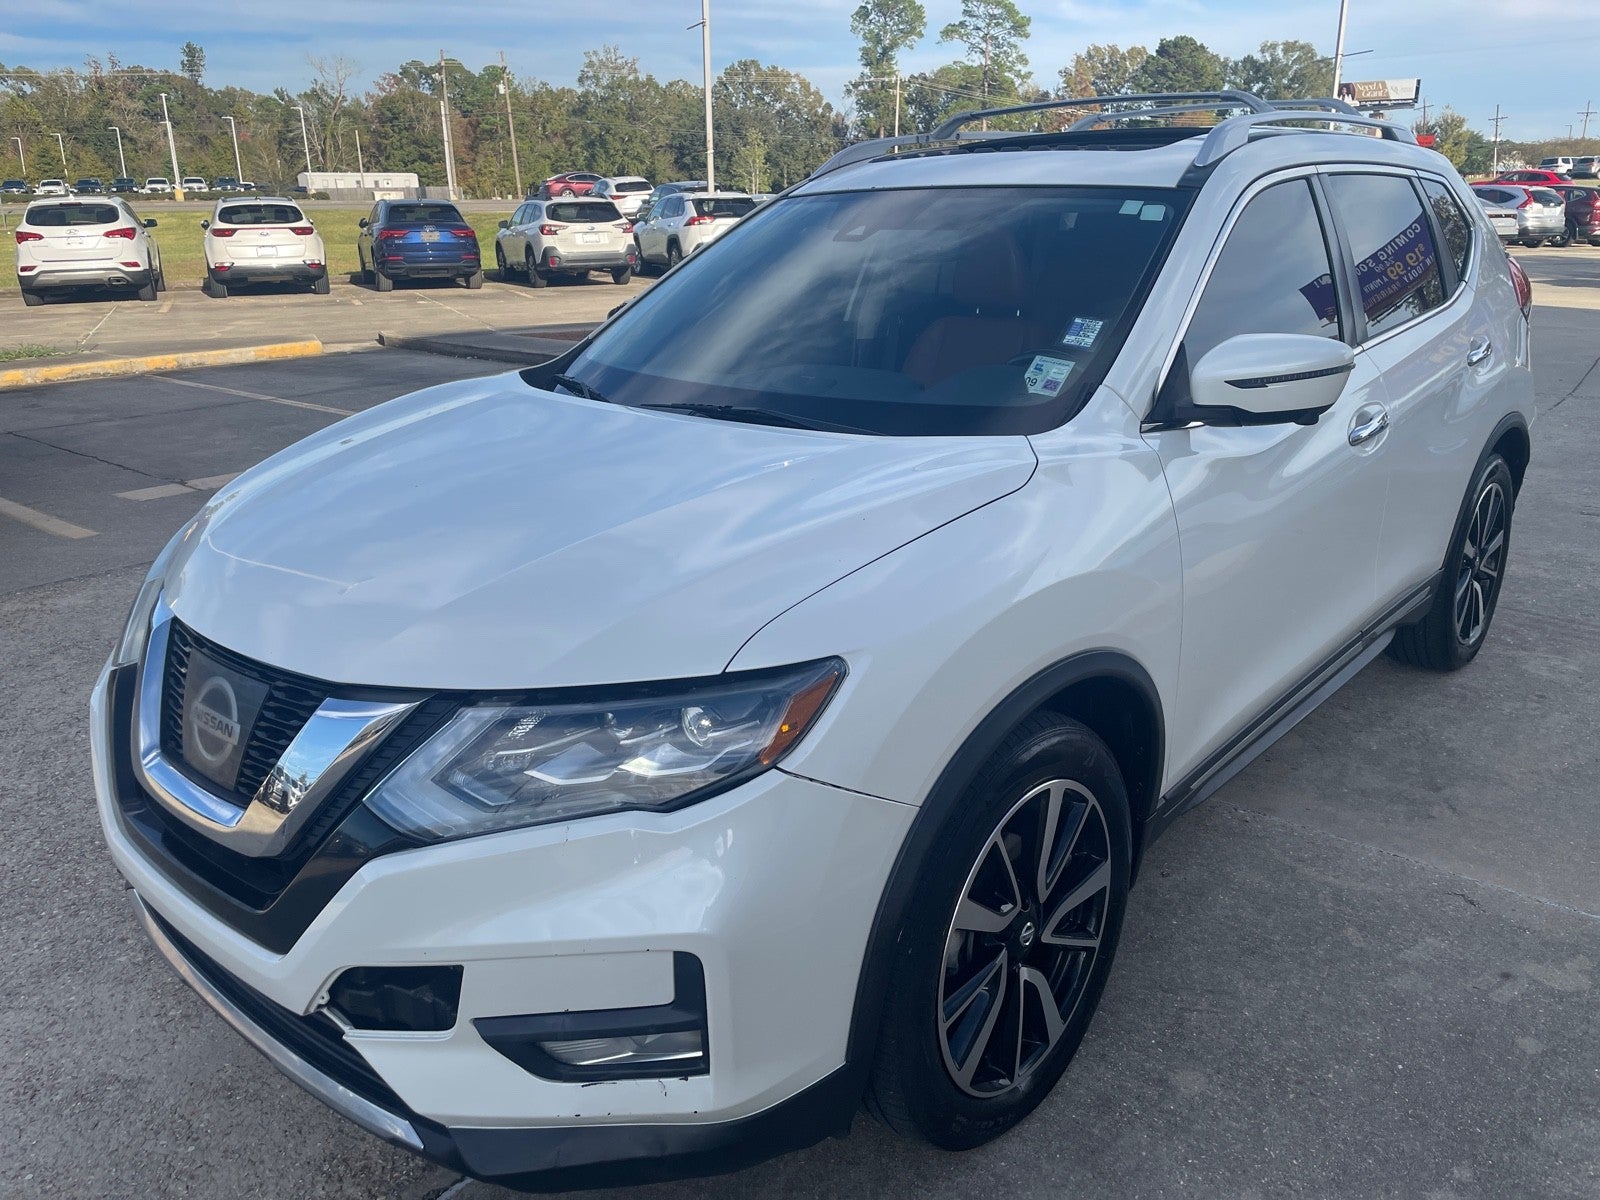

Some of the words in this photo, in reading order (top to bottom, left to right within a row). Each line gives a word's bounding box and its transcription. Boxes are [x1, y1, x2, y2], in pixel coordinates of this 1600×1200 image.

[1357, 82, 1376, 91] Need
[1362, 88, 1388, 97] Grant?
[193, 704, 234, 738] NISSAN
